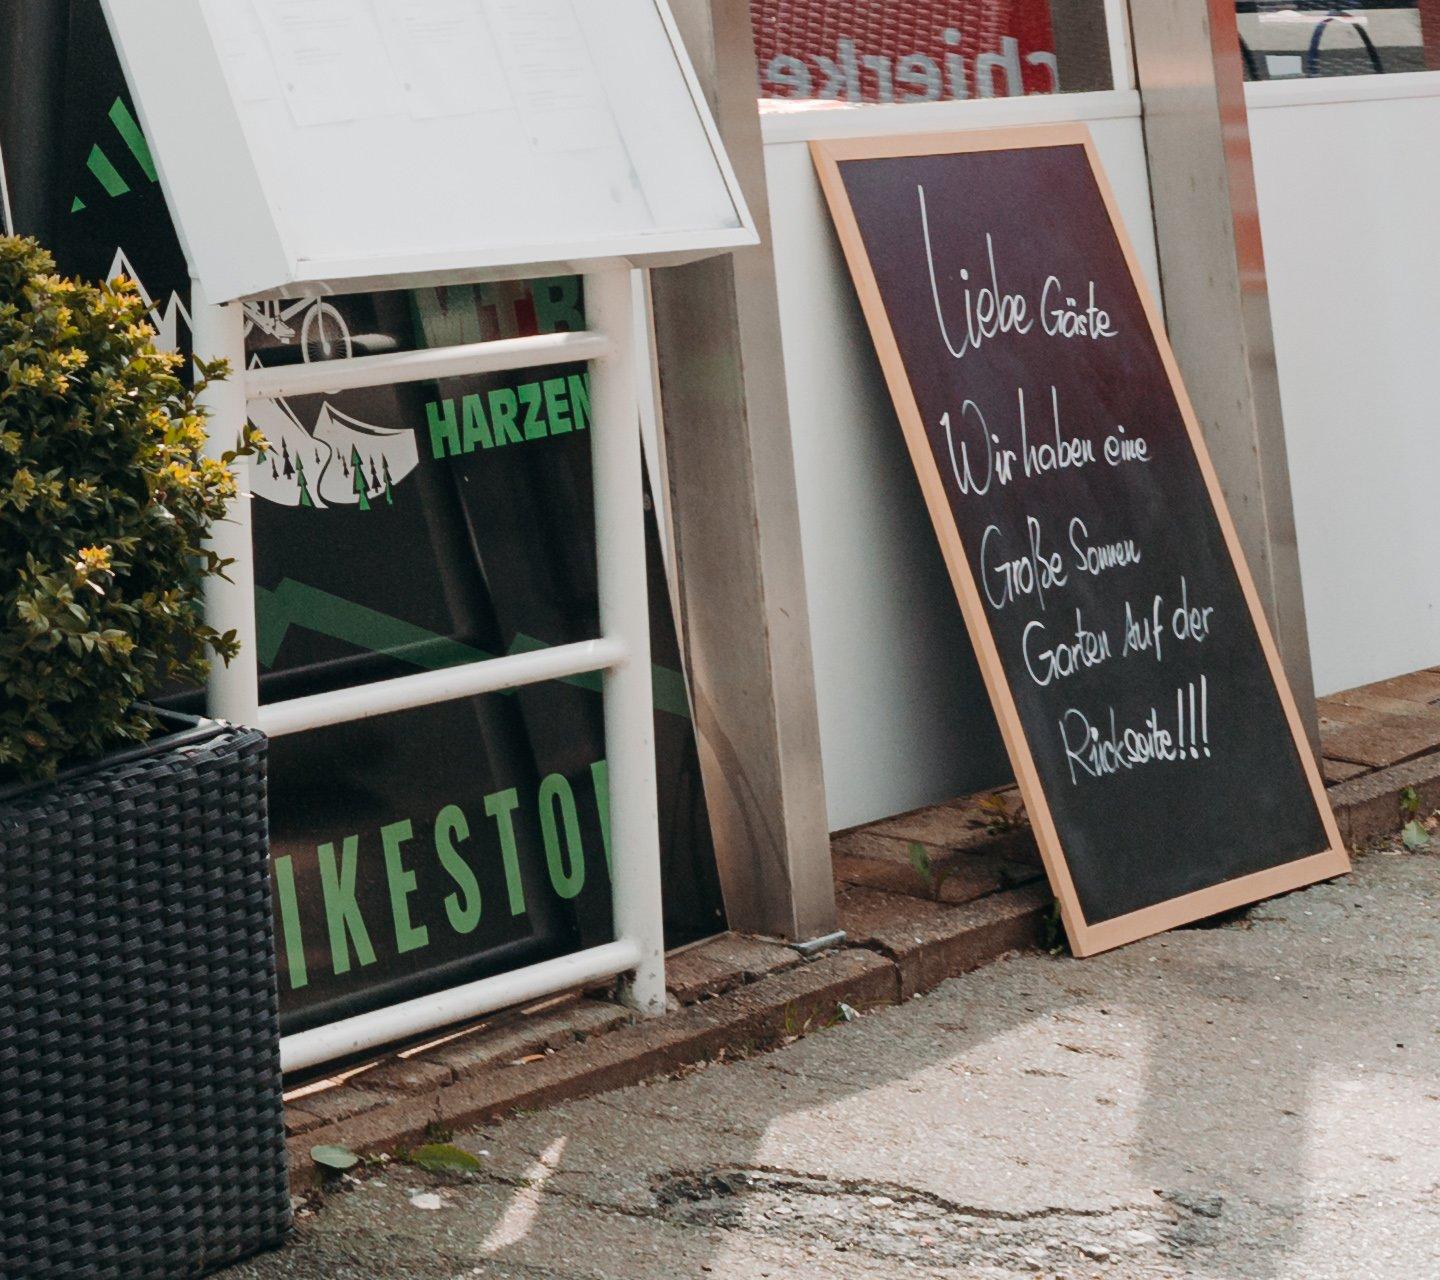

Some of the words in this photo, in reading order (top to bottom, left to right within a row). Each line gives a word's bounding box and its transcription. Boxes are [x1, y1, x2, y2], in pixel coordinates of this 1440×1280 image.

[917, 184, 1034, 359] Liebe
[1040, 275, 1119, 340] Gäste
[939, 399, 1017, 496] Wir
[1018, 385, 1097, 477] haben
[1103, 425, 1153, 467] eine
[981, 515, 1068, 611] Große
[1022, 607, 1112, 686] Garten
[1171, 574, 1215, 642] der
[274, 758, 614, 990] IKESTO
